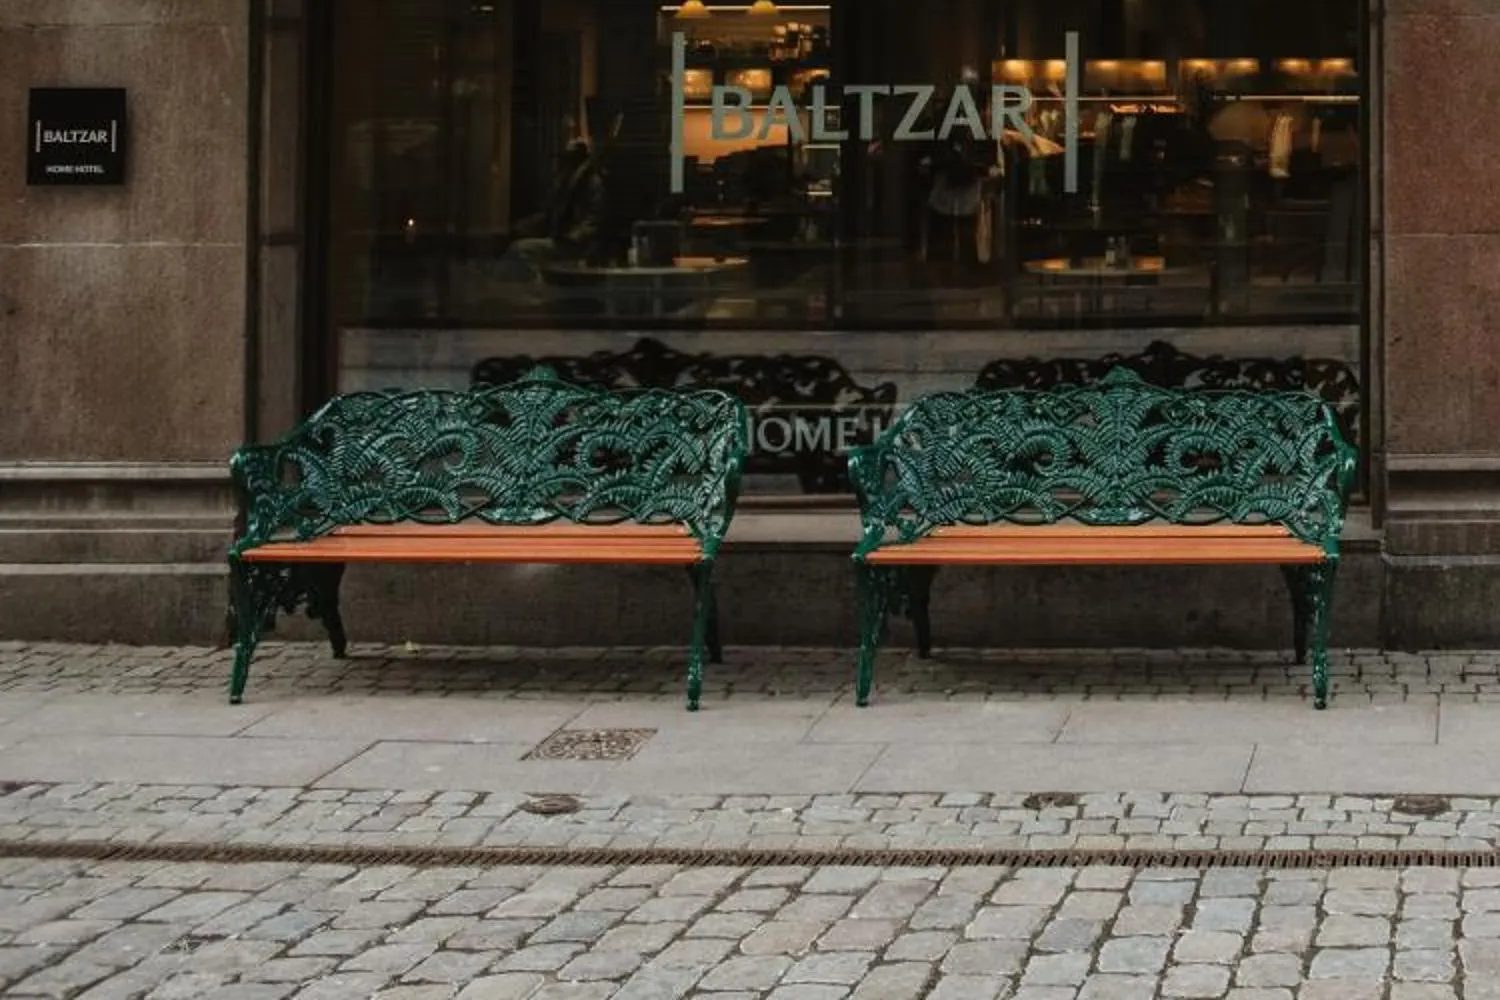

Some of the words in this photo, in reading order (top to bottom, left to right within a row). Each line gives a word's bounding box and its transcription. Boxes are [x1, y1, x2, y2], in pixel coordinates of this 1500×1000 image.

[711, 84, 1035, 142] BALTZAR
[43, 130, 107, 143] BALTZAR
[745, 415, 859, 454] OME
